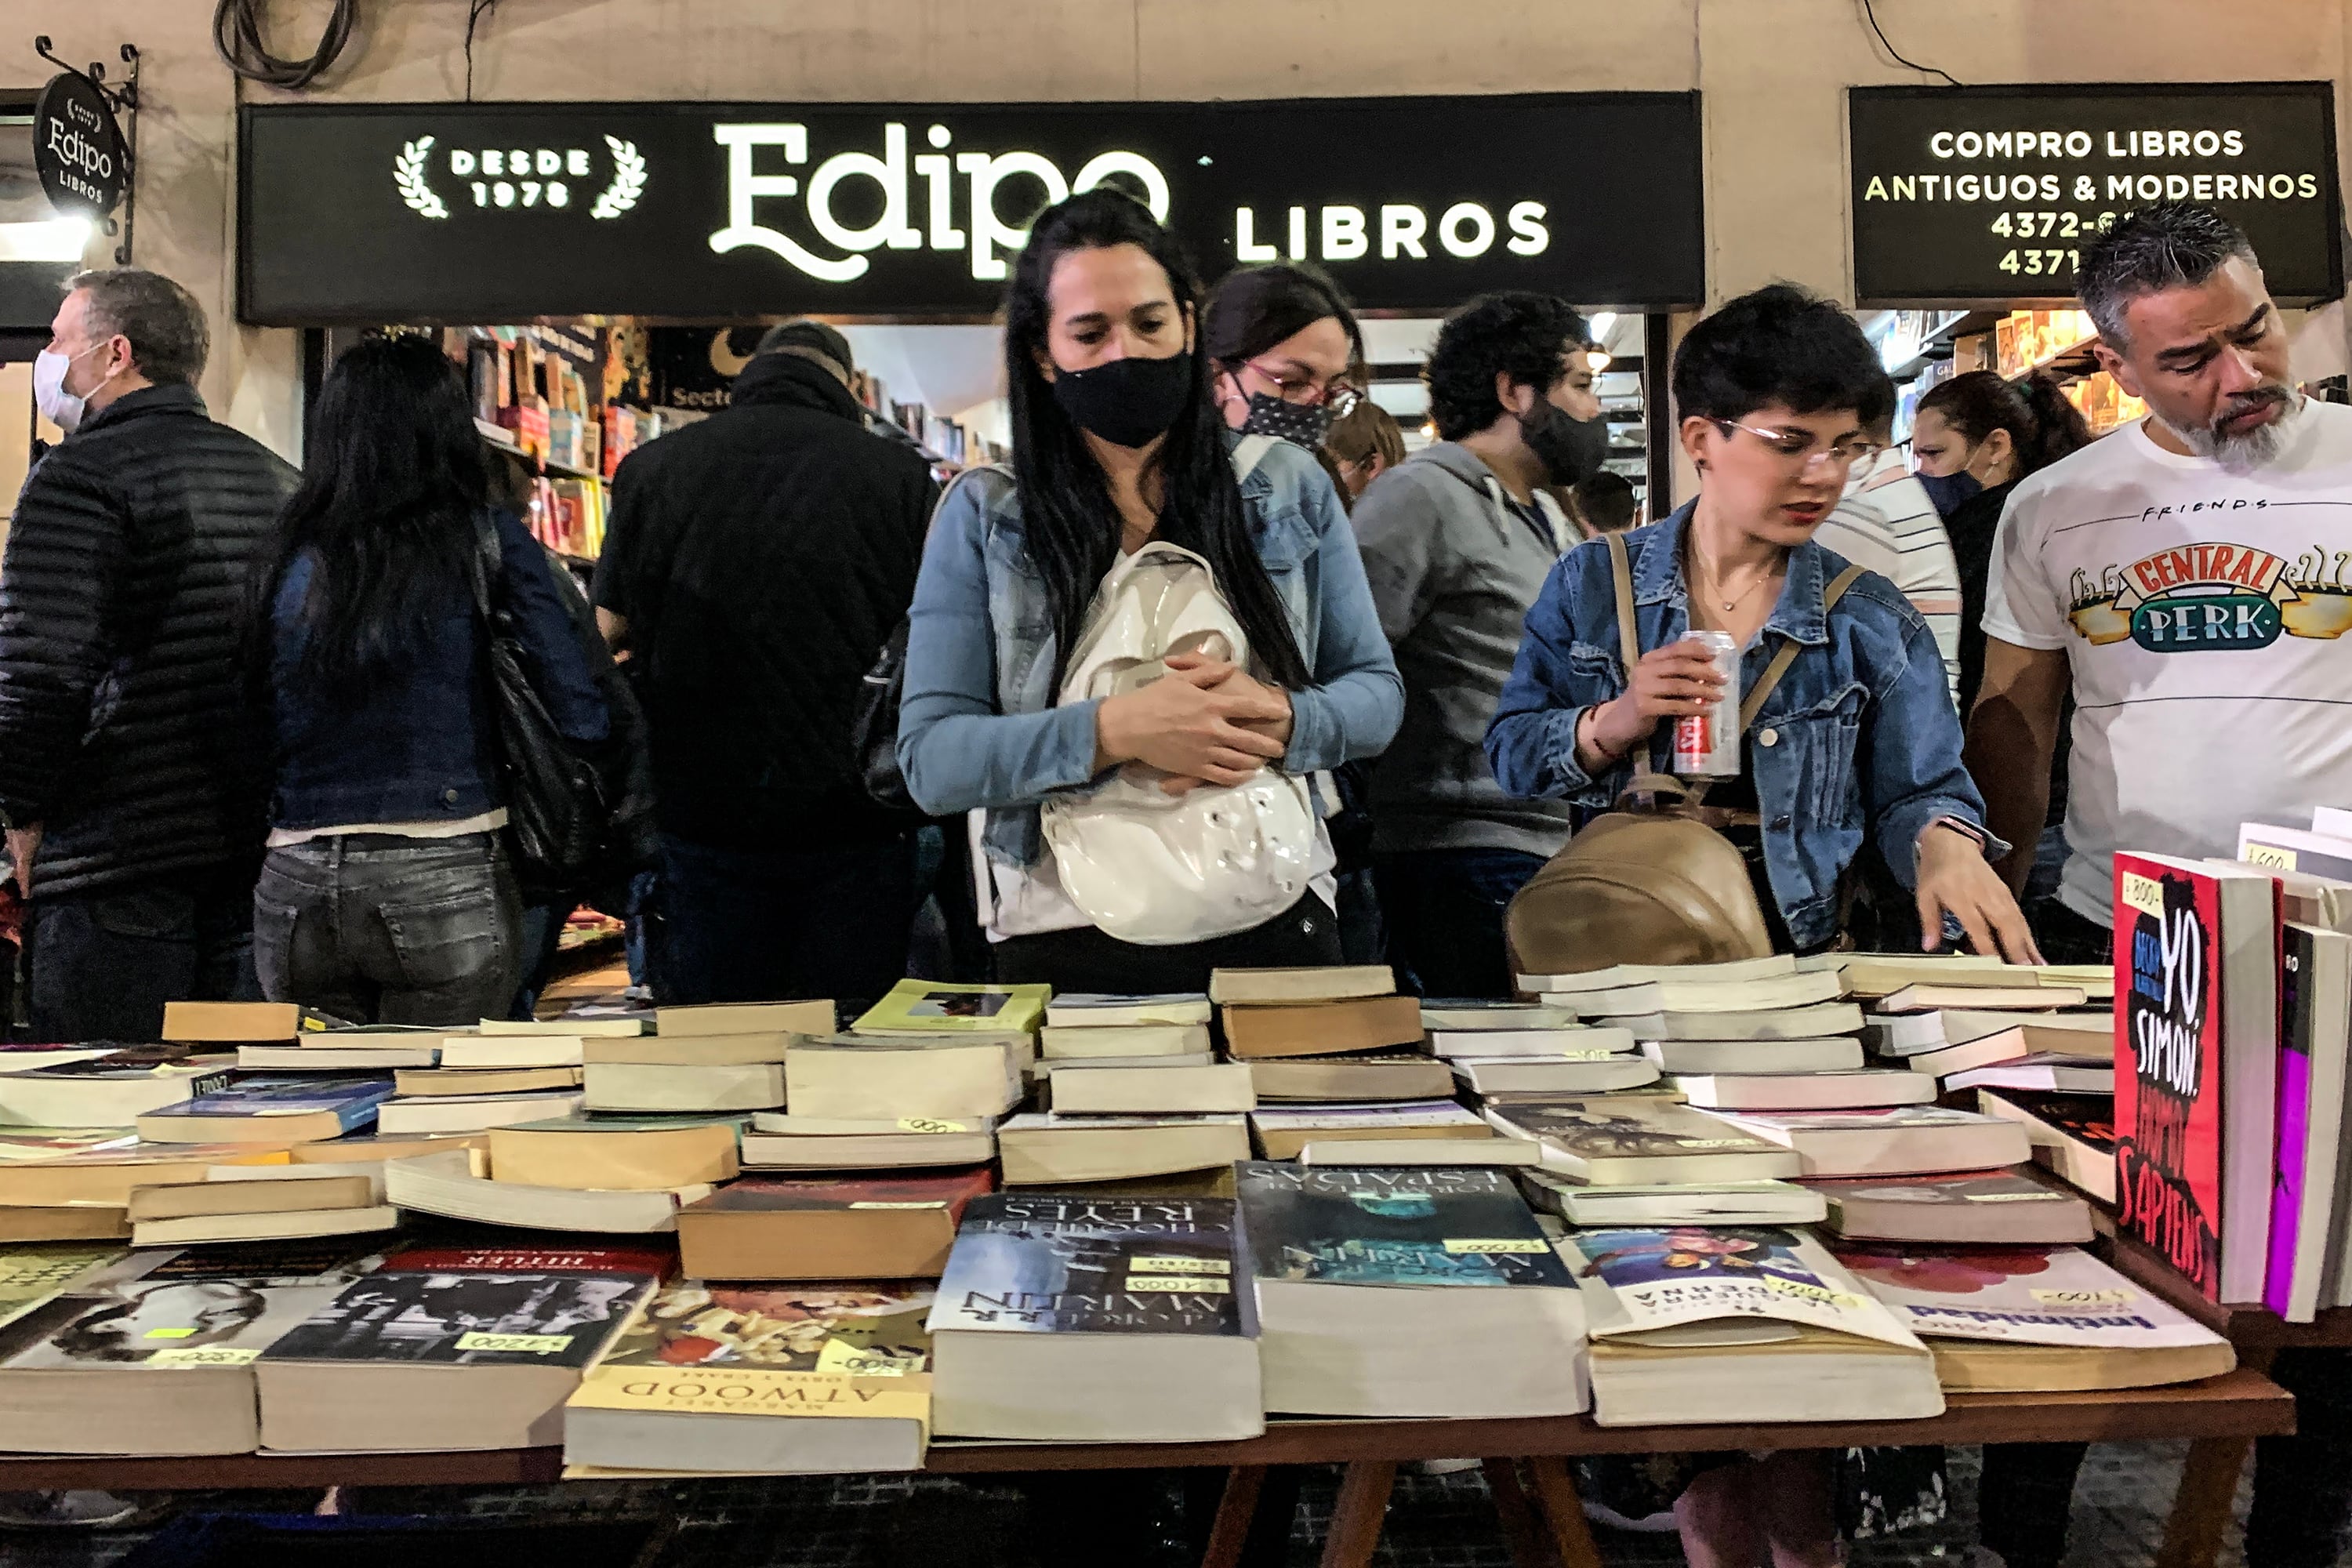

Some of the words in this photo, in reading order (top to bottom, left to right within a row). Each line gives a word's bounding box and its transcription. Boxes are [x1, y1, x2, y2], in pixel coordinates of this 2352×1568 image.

[48, 117, 111, 178] Edipo
[1930, 131, 2092, 158] COMPRO
[2107, 130, 2244, 158] LIBROS
[450, 150, 590, 176] DESDE
[60, 169, 103, 203] LIBROS
[470, 181, 569, 208] 1978
[1864, 175, 2060, 201] ANTIGUOS
[2074, 175, 2096, 201] &
[2107, 174, 2318, 201] MODERNOS
[709, 123, 1171, 282] Edipo
[1236, 201, 1550, 261] LIBROS
[2133, 546, 2276, 593] CENTRAL
[2146, 603, 2265, 642] PERK
[1247, 1168, 1498, 1185] ESPADAS
[1005, 1203, 1193, 1222] REYES
[2118, 1145, 2205, 1283] SAPIENS
[1047, 1220, 1230, 1234] CHOQUE
[466, 1255, 585, 1269] HITLER
[960, 1291, 1222, 1312] MARTIN
[620, 1382, 884, 1403] ATWOOD
[663, 1399, 825, 1410] MARGARET
